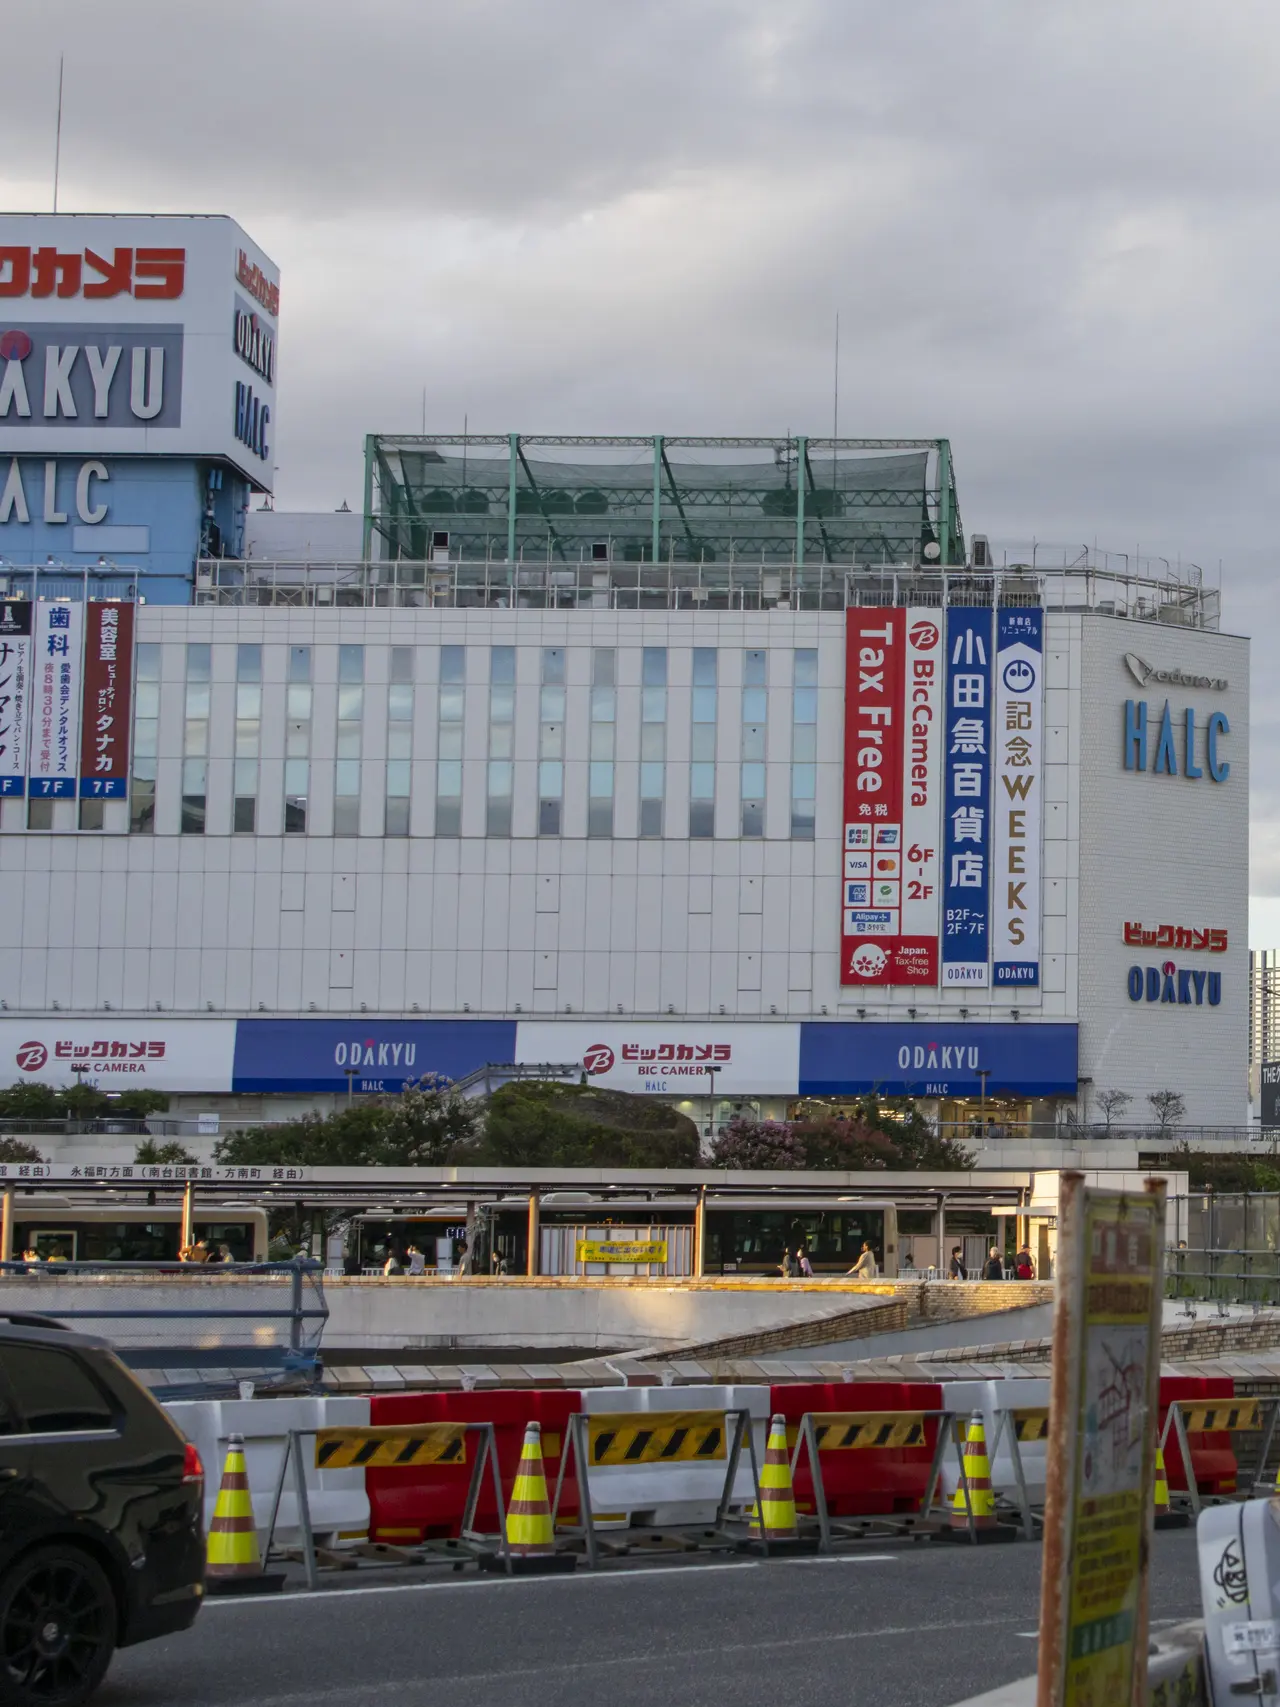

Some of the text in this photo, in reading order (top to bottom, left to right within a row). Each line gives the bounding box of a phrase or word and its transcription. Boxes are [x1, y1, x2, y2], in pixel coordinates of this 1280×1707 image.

[235, 309, 275, 383] ODAKYU
[234, 380, 271, 460] HALC
[1008, 617, 1031, 626] 新宿店
[48, 607, 71, 657] 歯科
[99, 608, 119, 661] 美容室
[1001, 626, 1038, 636] リニューアル
[858, 621, 893, 693] Tax
[98, 688, 107, 713] サロン
[95, 714, 115, 772] タナカ
[856, 706, 892, 792] Free
[1124, 699, 1231, 782] HALC
[949, 627, 988, 888] 小田急百貨店
[42, 781, 64, 793] 7F
[93, 781, 115, 793] 7F
[858, 803, 888, 817] 免税
[907, 843, 934, 863] 6F
[850, 861, 868, 869] VISA
[907, 881, 934, 900] 2F
[1123, 921, 1228, 952] ビックカメラ
[898, 946, 929, 955] Japan.
[894, 956, 929, 965] Tax-free
[906, 965, 929, 975] Shop
[947, 967, 983, 980] ODAKYU
[998, 966, 1034, 979] ODAKYU
[1127, 962, 1222, 1006] ODAKYU
[55, 1041, 166, 1058] ビックカメラ
[335, 1040, 416, 1066] ODAKYU
[621, 1044, 732, 1061] ビックカメラ
[898, 1043, 979, 1069] ODAKYU
[94, 1063, 146, 1073] CAMERA
[638, 1066, 658, 1076] BIC
[361, 1080, 384, 1091] HALC
[645, 1080, 668, 1092] HALC
[926, 1083, 949, 1094] HALC
